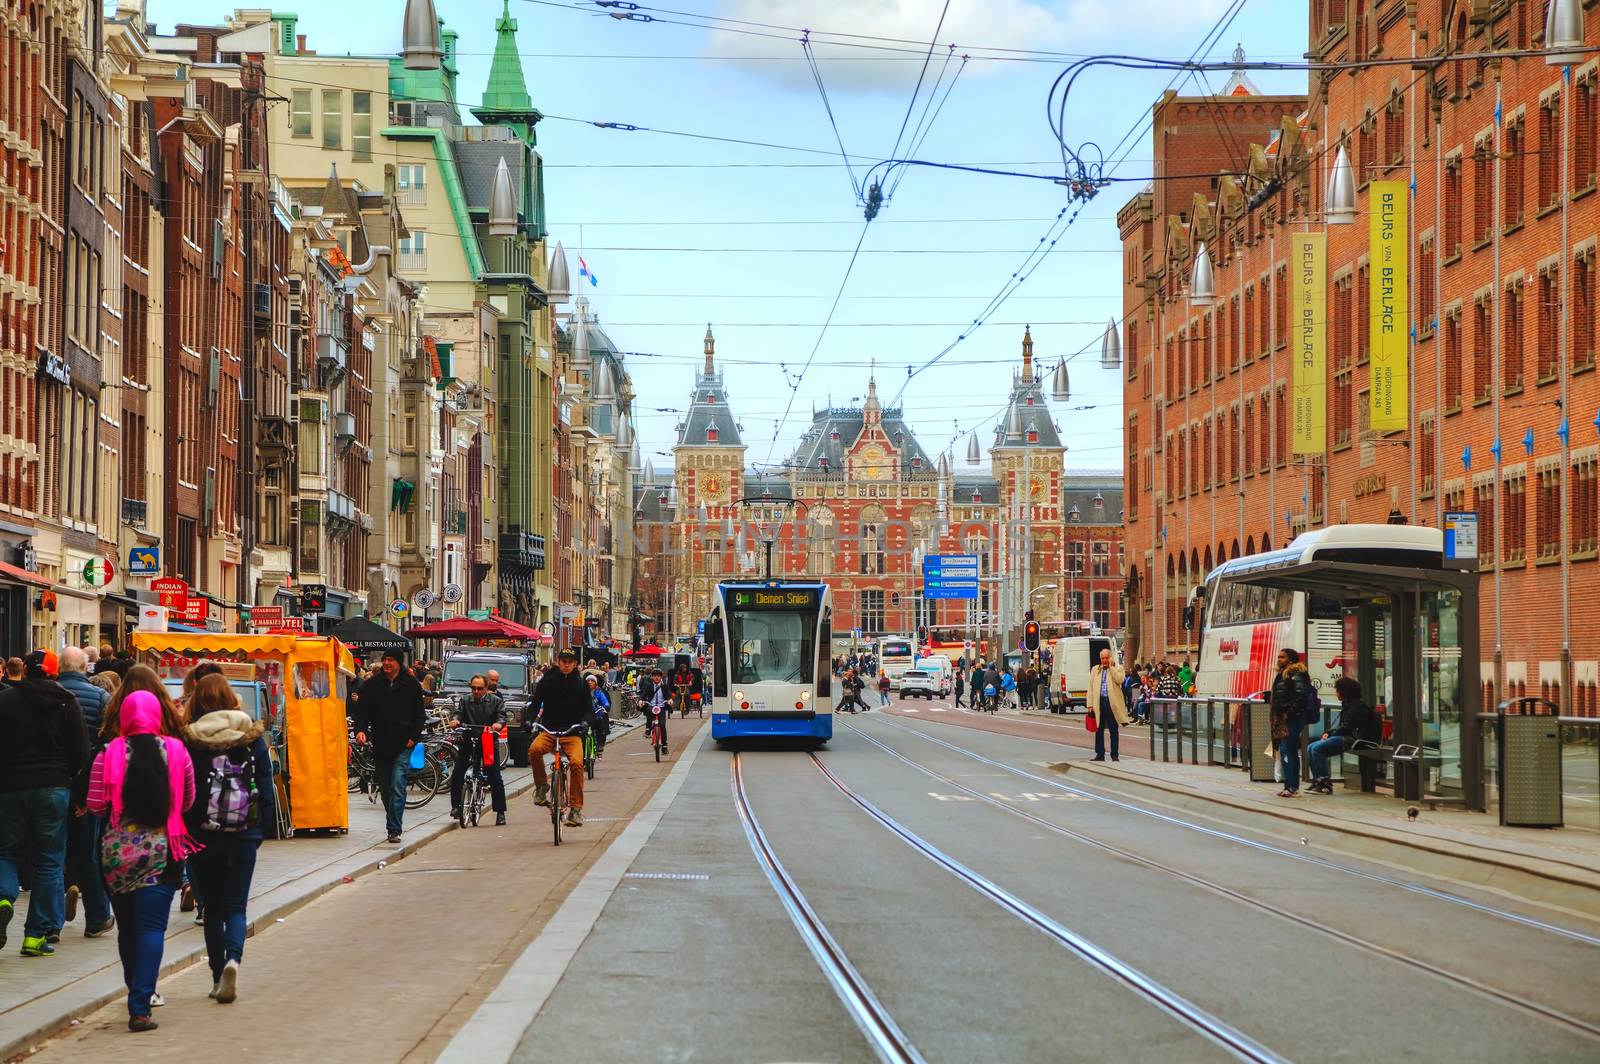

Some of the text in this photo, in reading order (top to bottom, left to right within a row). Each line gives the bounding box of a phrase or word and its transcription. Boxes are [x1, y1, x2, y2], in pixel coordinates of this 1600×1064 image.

[1382, 193, 1394, 240] BEURS
[1303, 243, 1314, 285] BEURS
[1382, 267, 1394, 334] BERLAGE
[1303, 309, 1314, 369] BERLAGE
[735, 592, 809, 605] 9 Diemen Sniep
